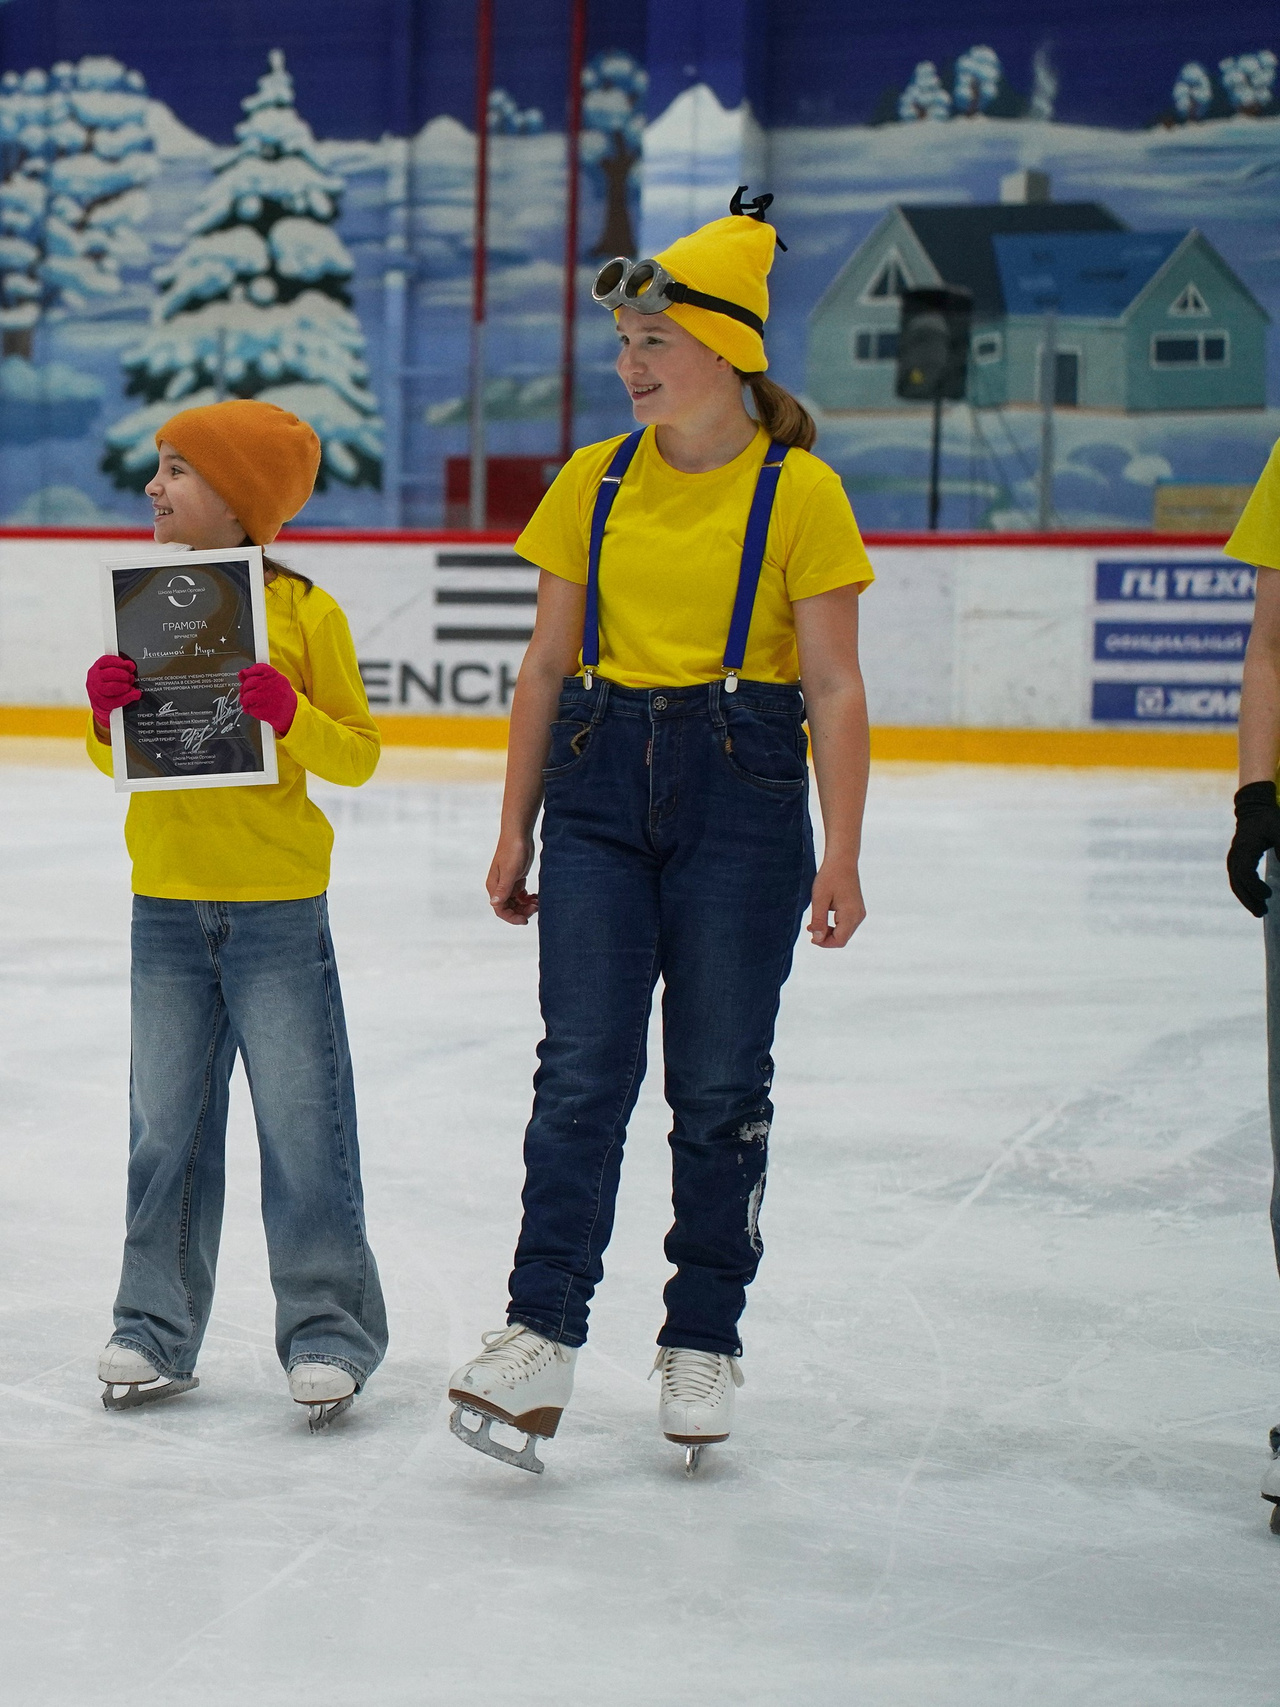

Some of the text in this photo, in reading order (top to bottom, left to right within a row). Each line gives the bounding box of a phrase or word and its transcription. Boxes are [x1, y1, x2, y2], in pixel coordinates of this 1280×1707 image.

[1173, 568, 1257, 597] ТЕХН
[162, 620, 208, 632] ГРАМОТА
[358, 660, 518, 705] ENCH
